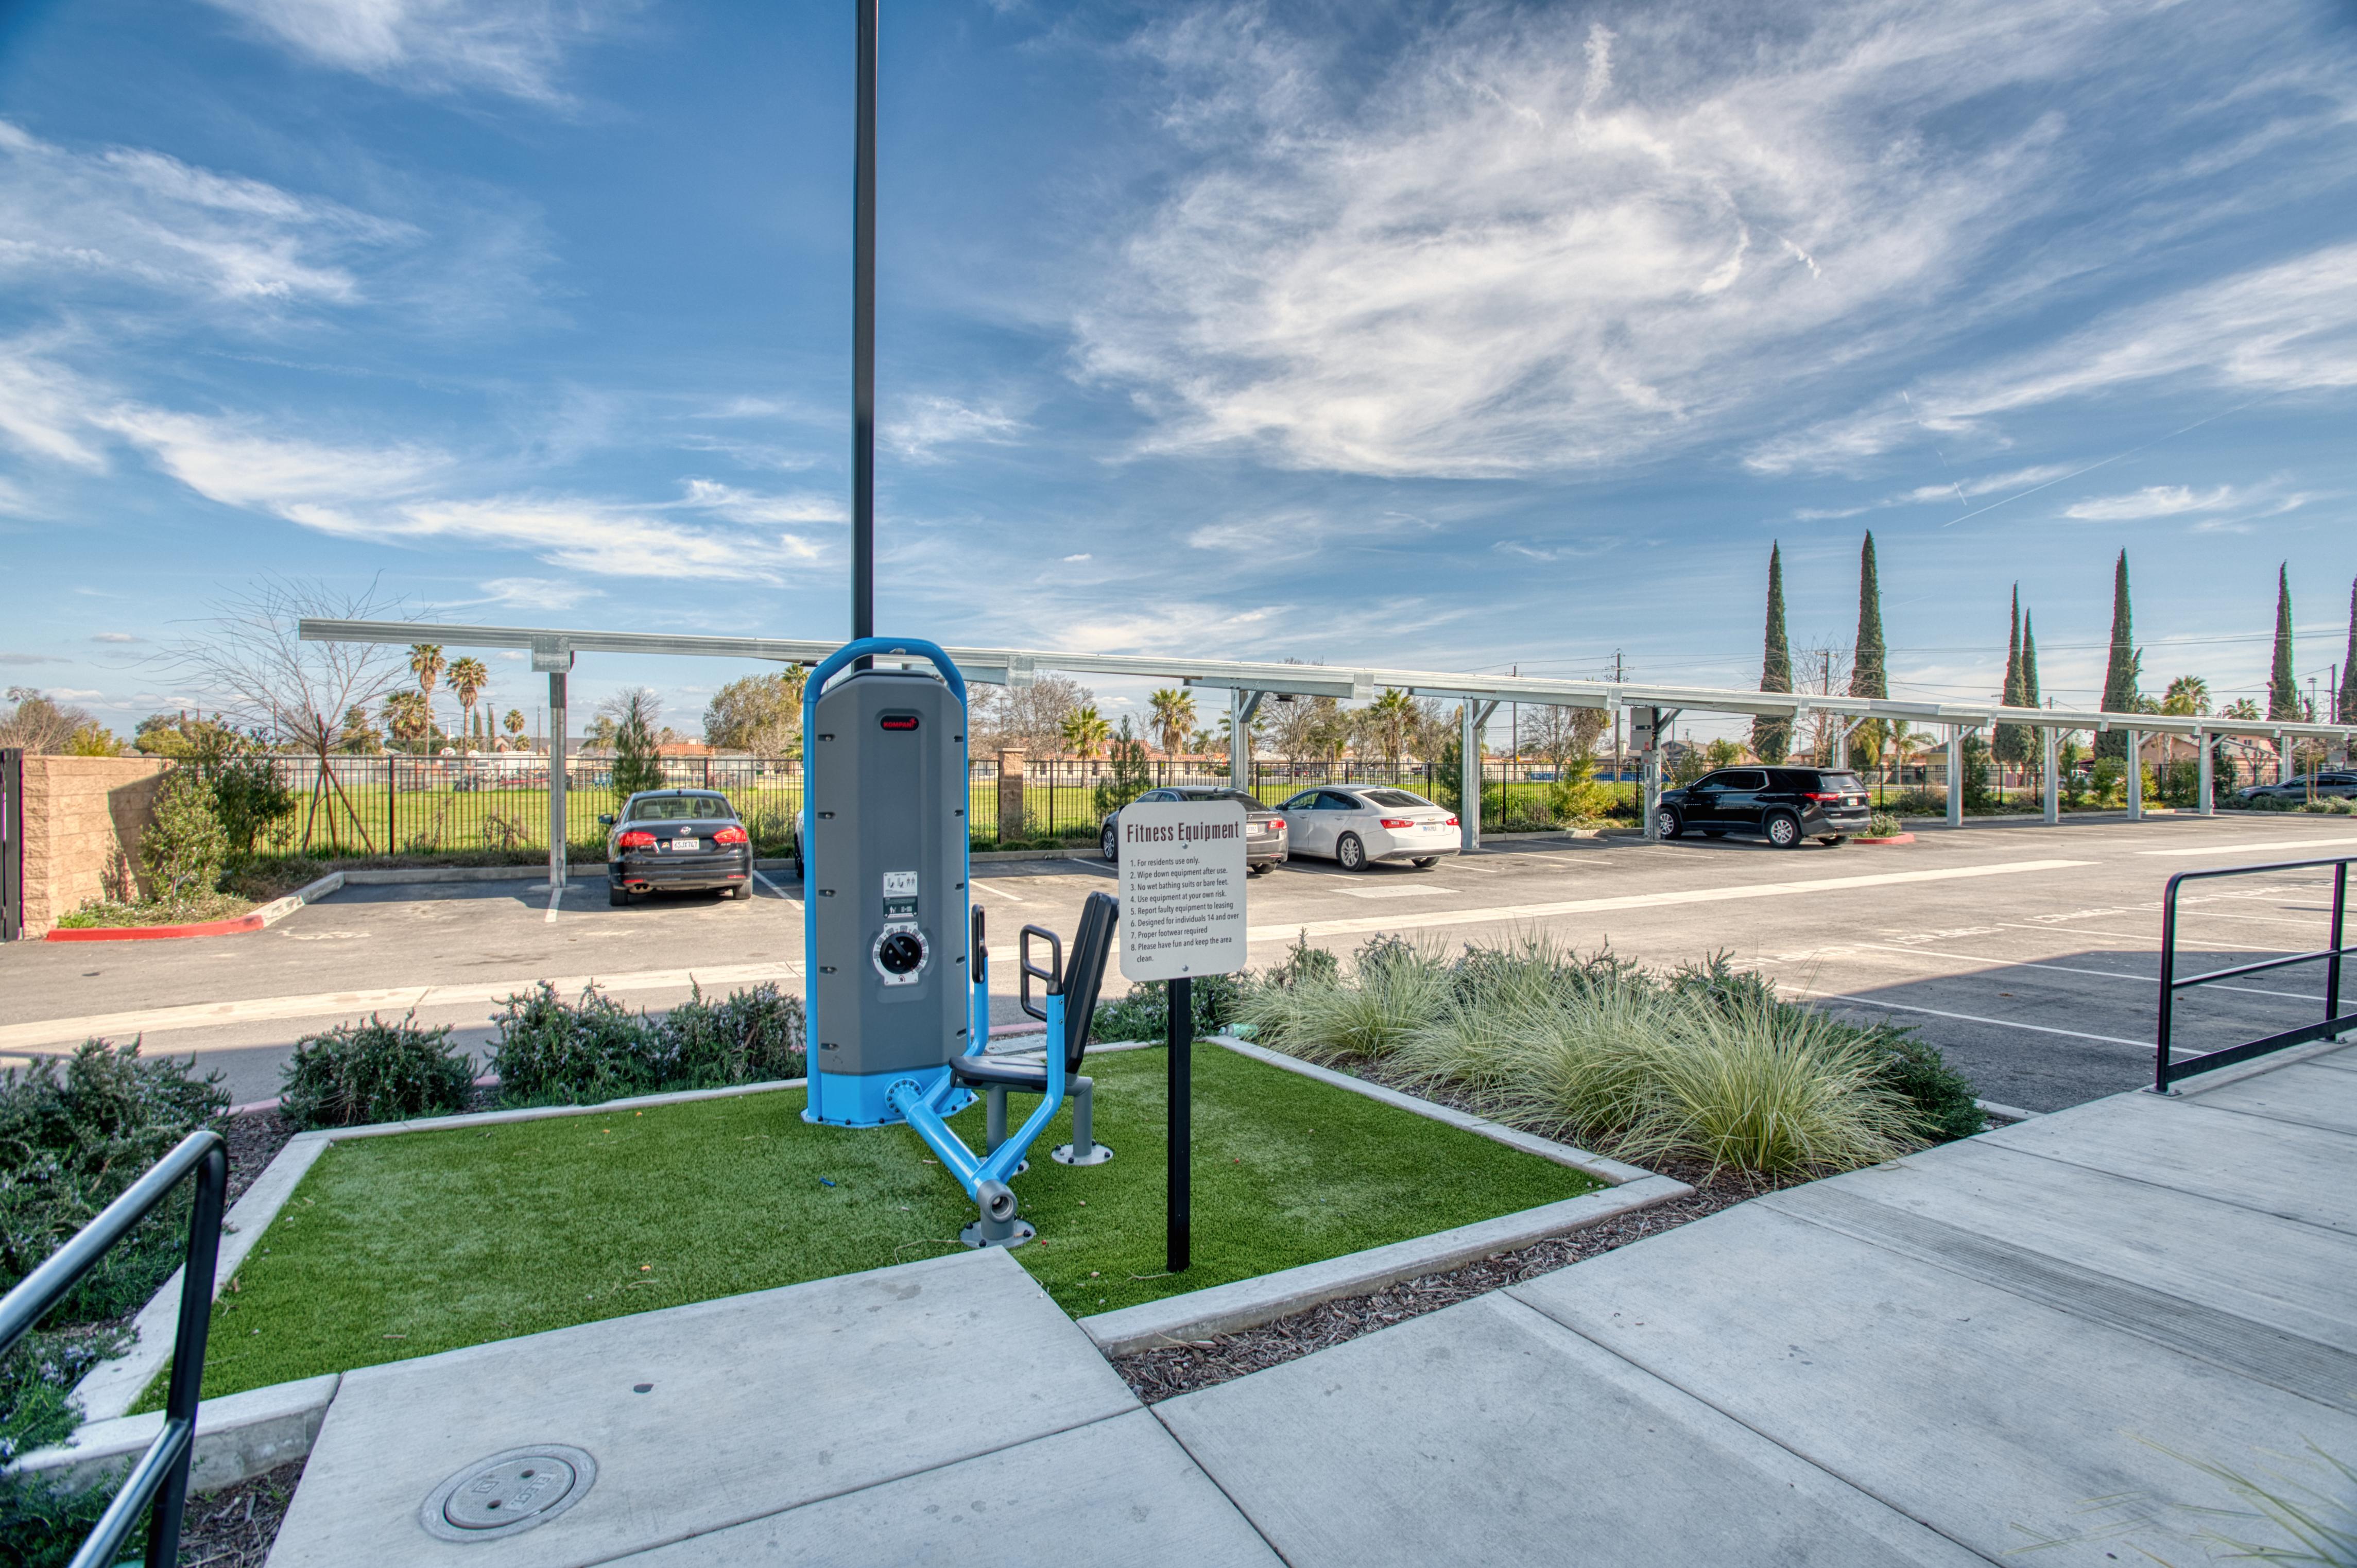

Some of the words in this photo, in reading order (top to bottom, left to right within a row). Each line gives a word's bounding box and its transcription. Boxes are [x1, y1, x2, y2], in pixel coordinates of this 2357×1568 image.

[1127, 824, 1174, 842] Fitness
[1178, 822, 1238, 842] Equipment
[1186, 856, 1199, 865] only.
[1137, 871, 1152, 880] Wipe
[1171, 869, 1201, 878] equipment
[1159, 882, 1180, 890] bathing
[1150, 894, 1180, 903] equipment
[1138, 907, 1157, 916] Report
[1158, 905, 1174, 914] faulty
[1175, 904, 1206, 913] equipment
[1138, 918, 1164, 927] Designed
[1176, 915, 1206, 923] individuals
[1184, 926, 1207, 936] required
[1195, 938, 1209, 946] keep
